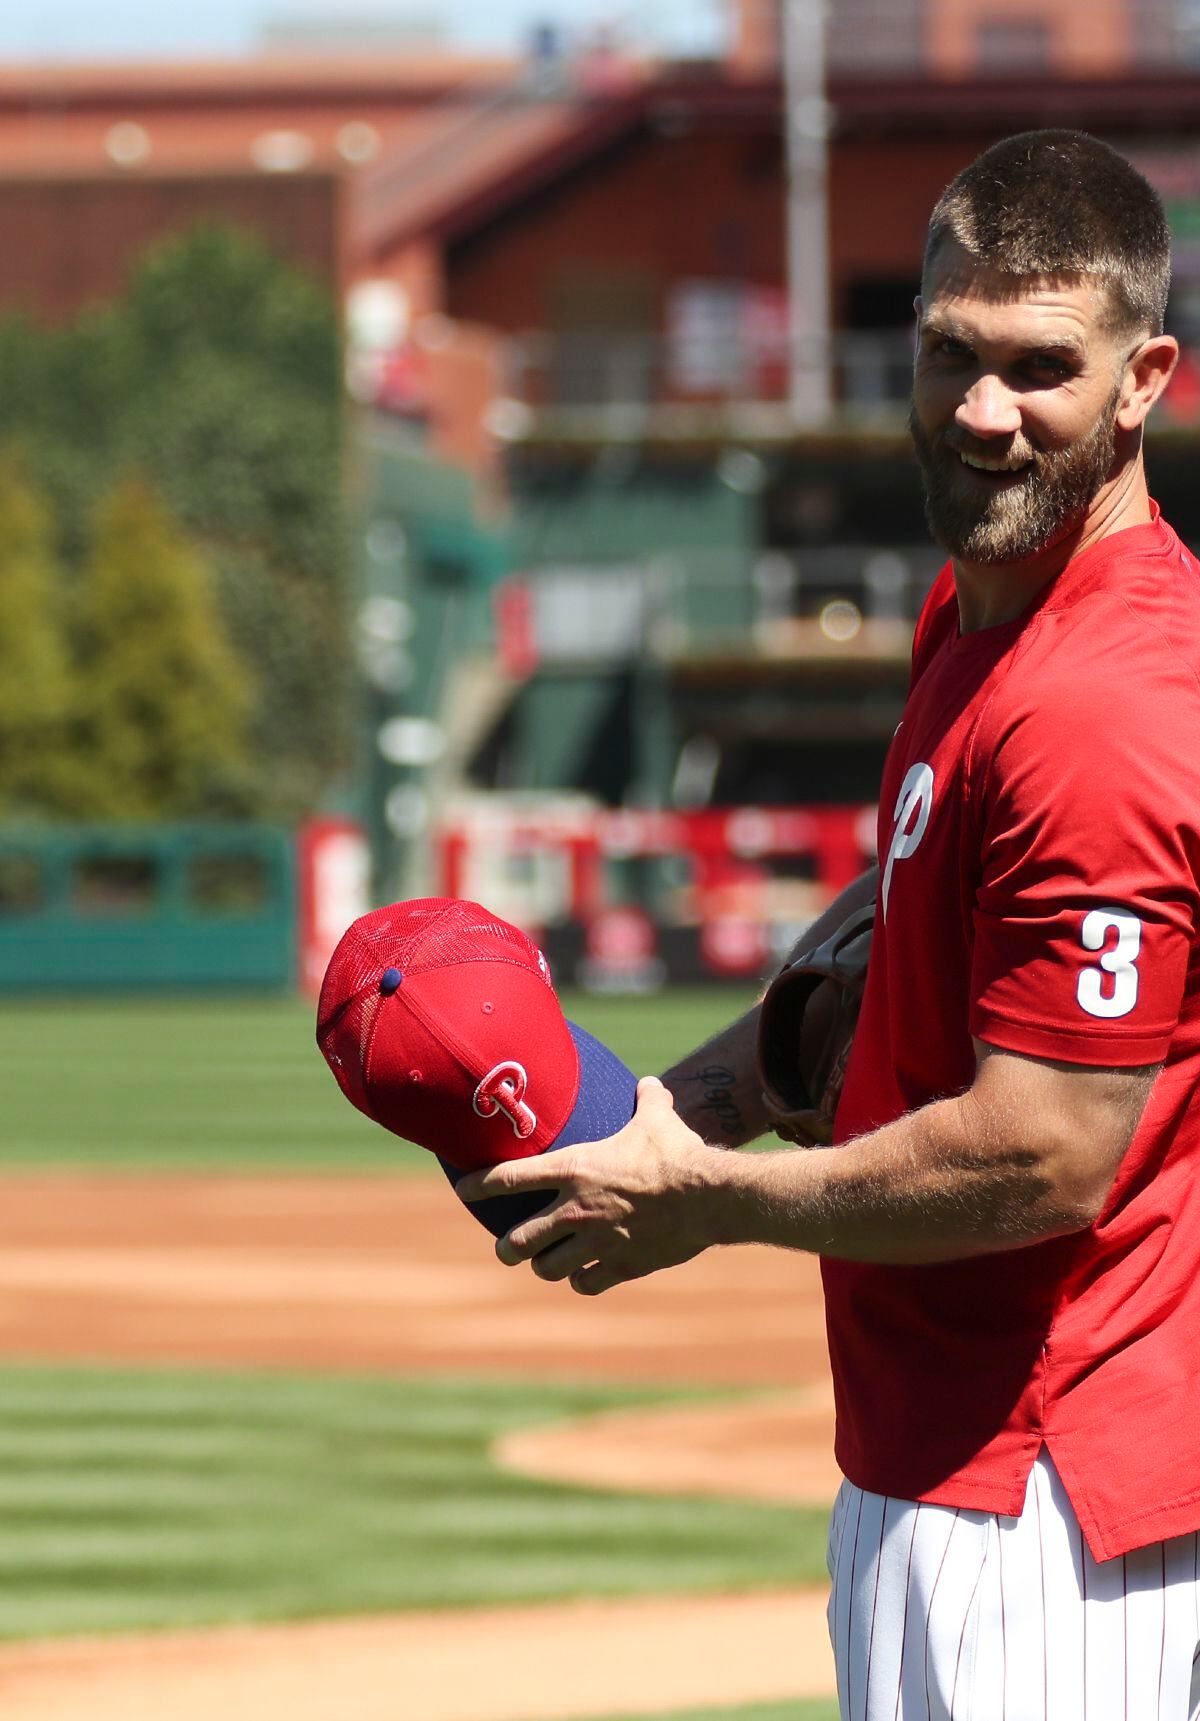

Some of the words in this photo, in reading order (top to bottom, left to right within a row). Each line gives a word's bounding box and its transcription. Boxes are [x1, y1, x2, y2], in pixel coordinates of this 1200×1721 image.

[881, 762, 934, 926] P
[1077, 906, 1142, 1018] 3
[473, 1061, 537, 1138] P
